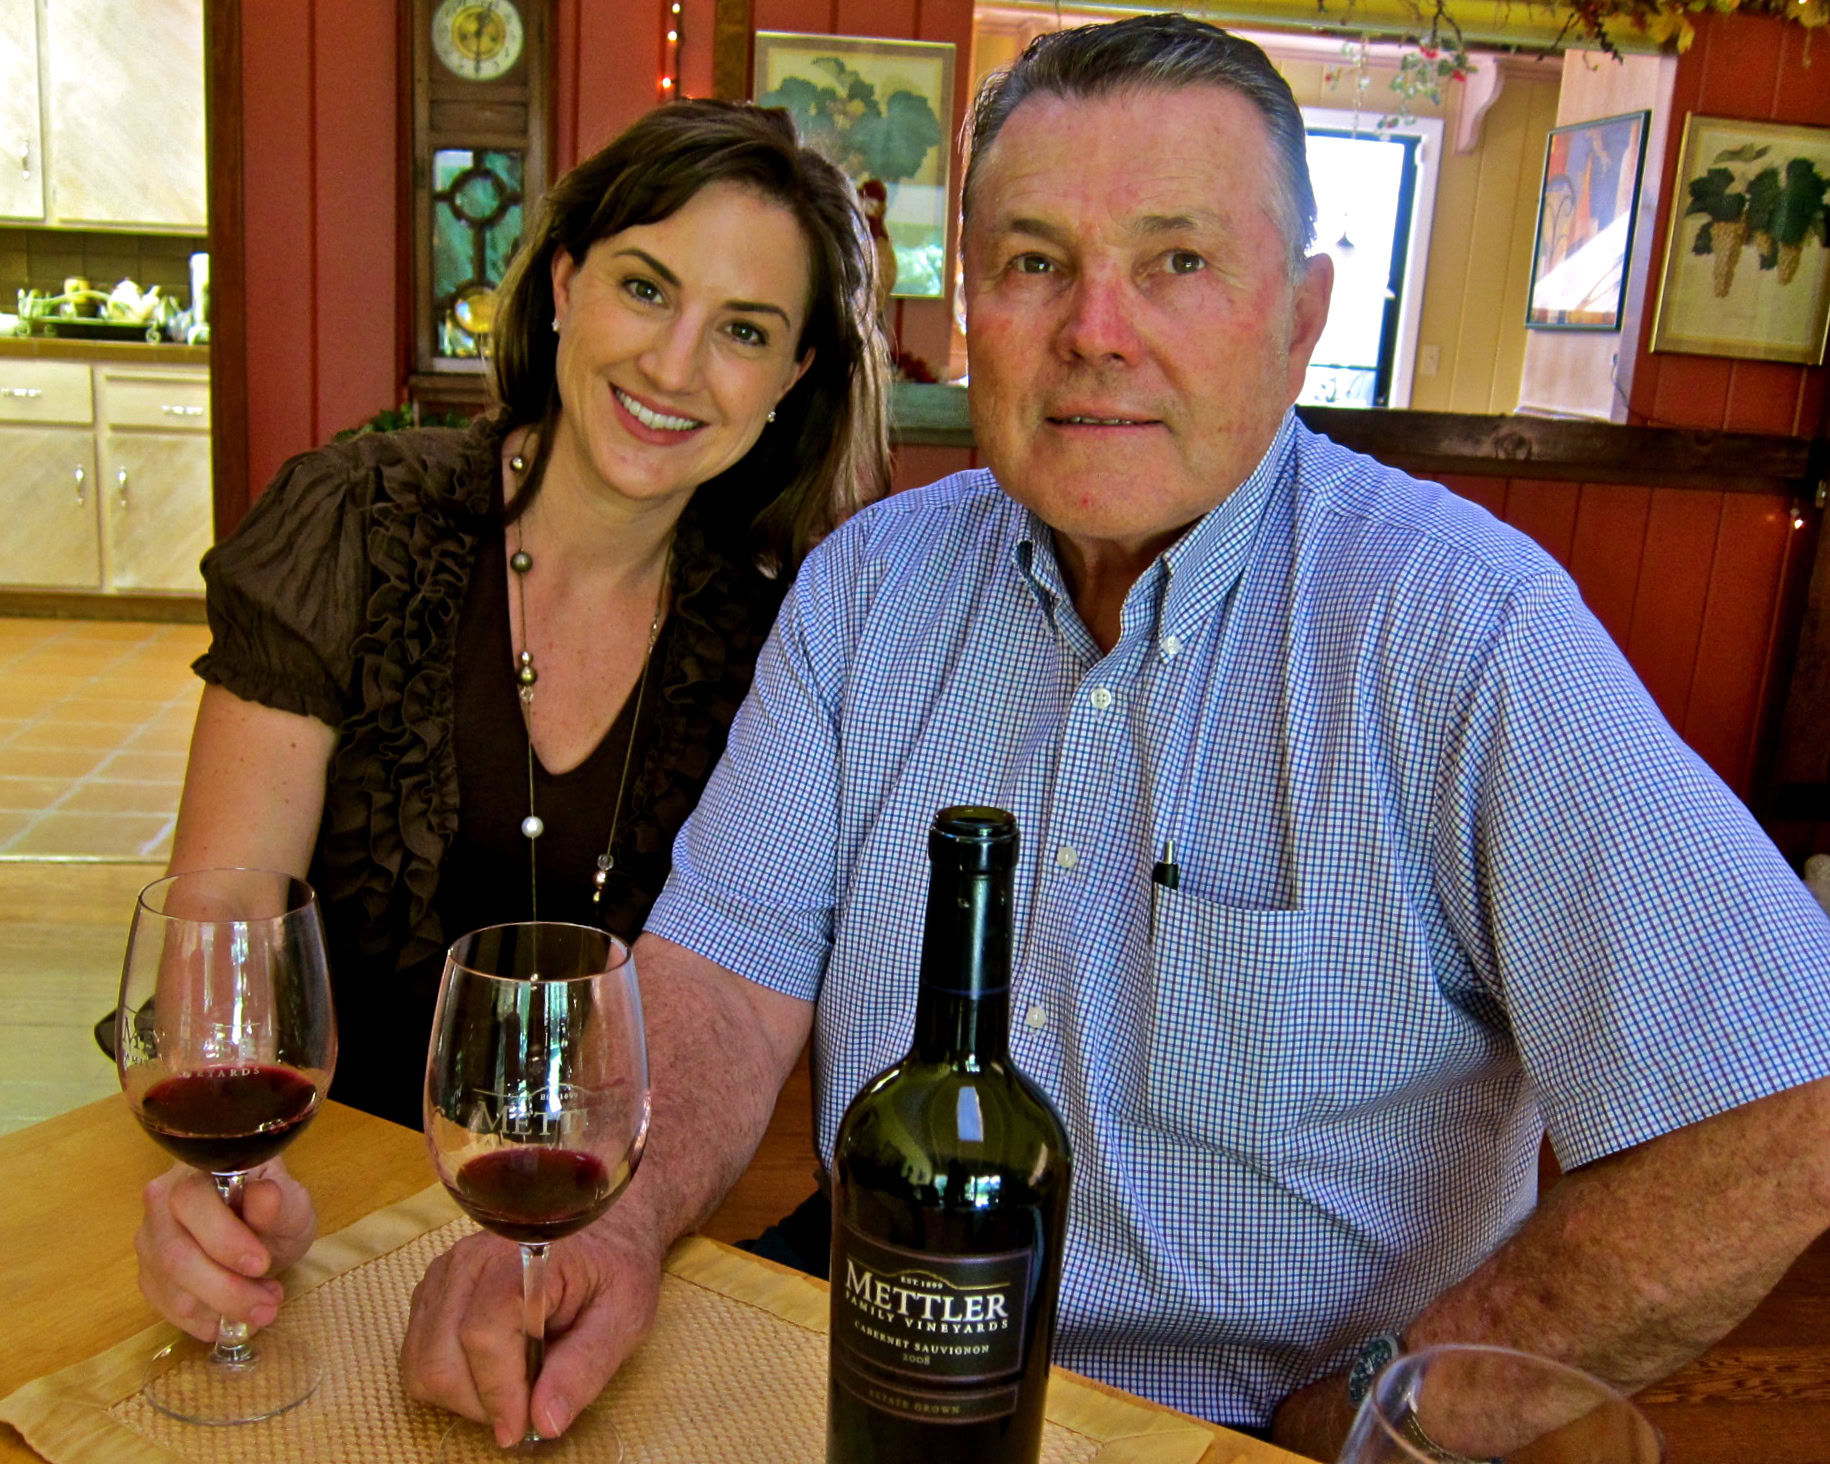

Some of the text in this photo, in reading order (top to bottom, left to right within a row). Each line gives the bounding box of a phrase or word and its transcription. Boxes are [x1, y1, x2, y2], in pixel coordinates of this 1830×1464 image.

[845, 1258, 1009, 1323] METTLER
[921, 1280, 944, 1290] 1899
[846, 1291, 1009, 1334] FAMILY VINEYARDS
[854, 1320, 990, 1356] CABERNET SAUVIGNON
[902, 1353, 931, 1366] 2008
[913, 1402, 960, 1414] GROWN
